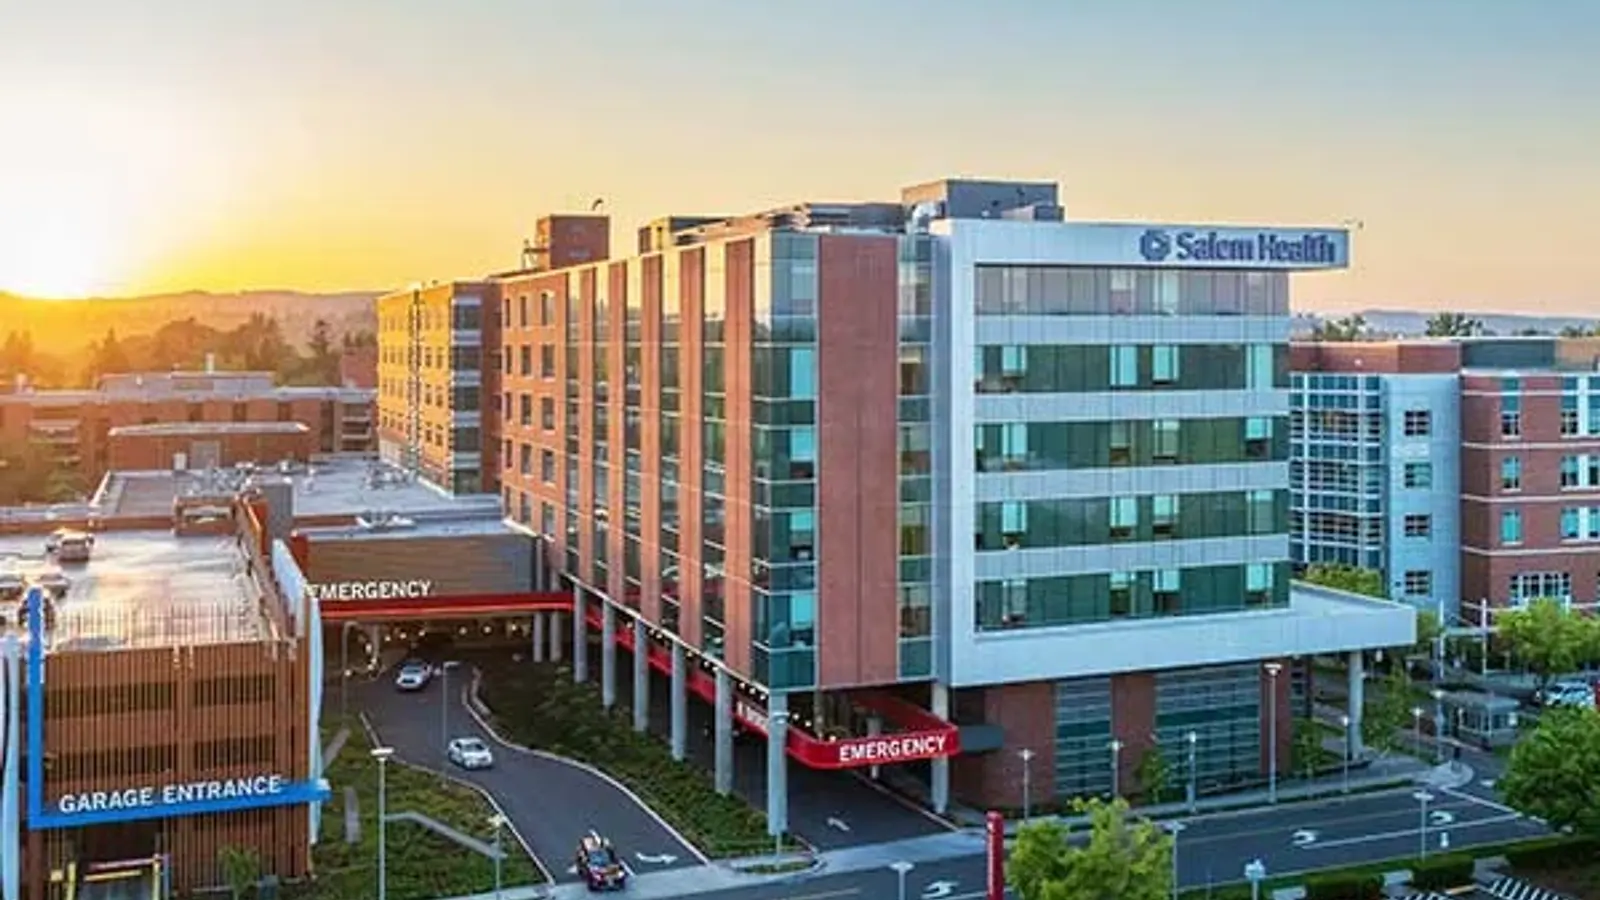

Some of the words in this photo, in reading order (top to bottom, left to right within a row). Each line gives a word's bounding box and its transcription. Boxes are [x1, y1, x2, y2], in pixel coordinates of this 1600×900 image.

[1176, 231, 1253, 260] Salem
[1258, 233, 1336, 262] Health
[839, 736, 946, 763] EMERGENCY
[59, 785, 153, 813] GARAGE
[162, 774, 281, 803] ENTRANCE
